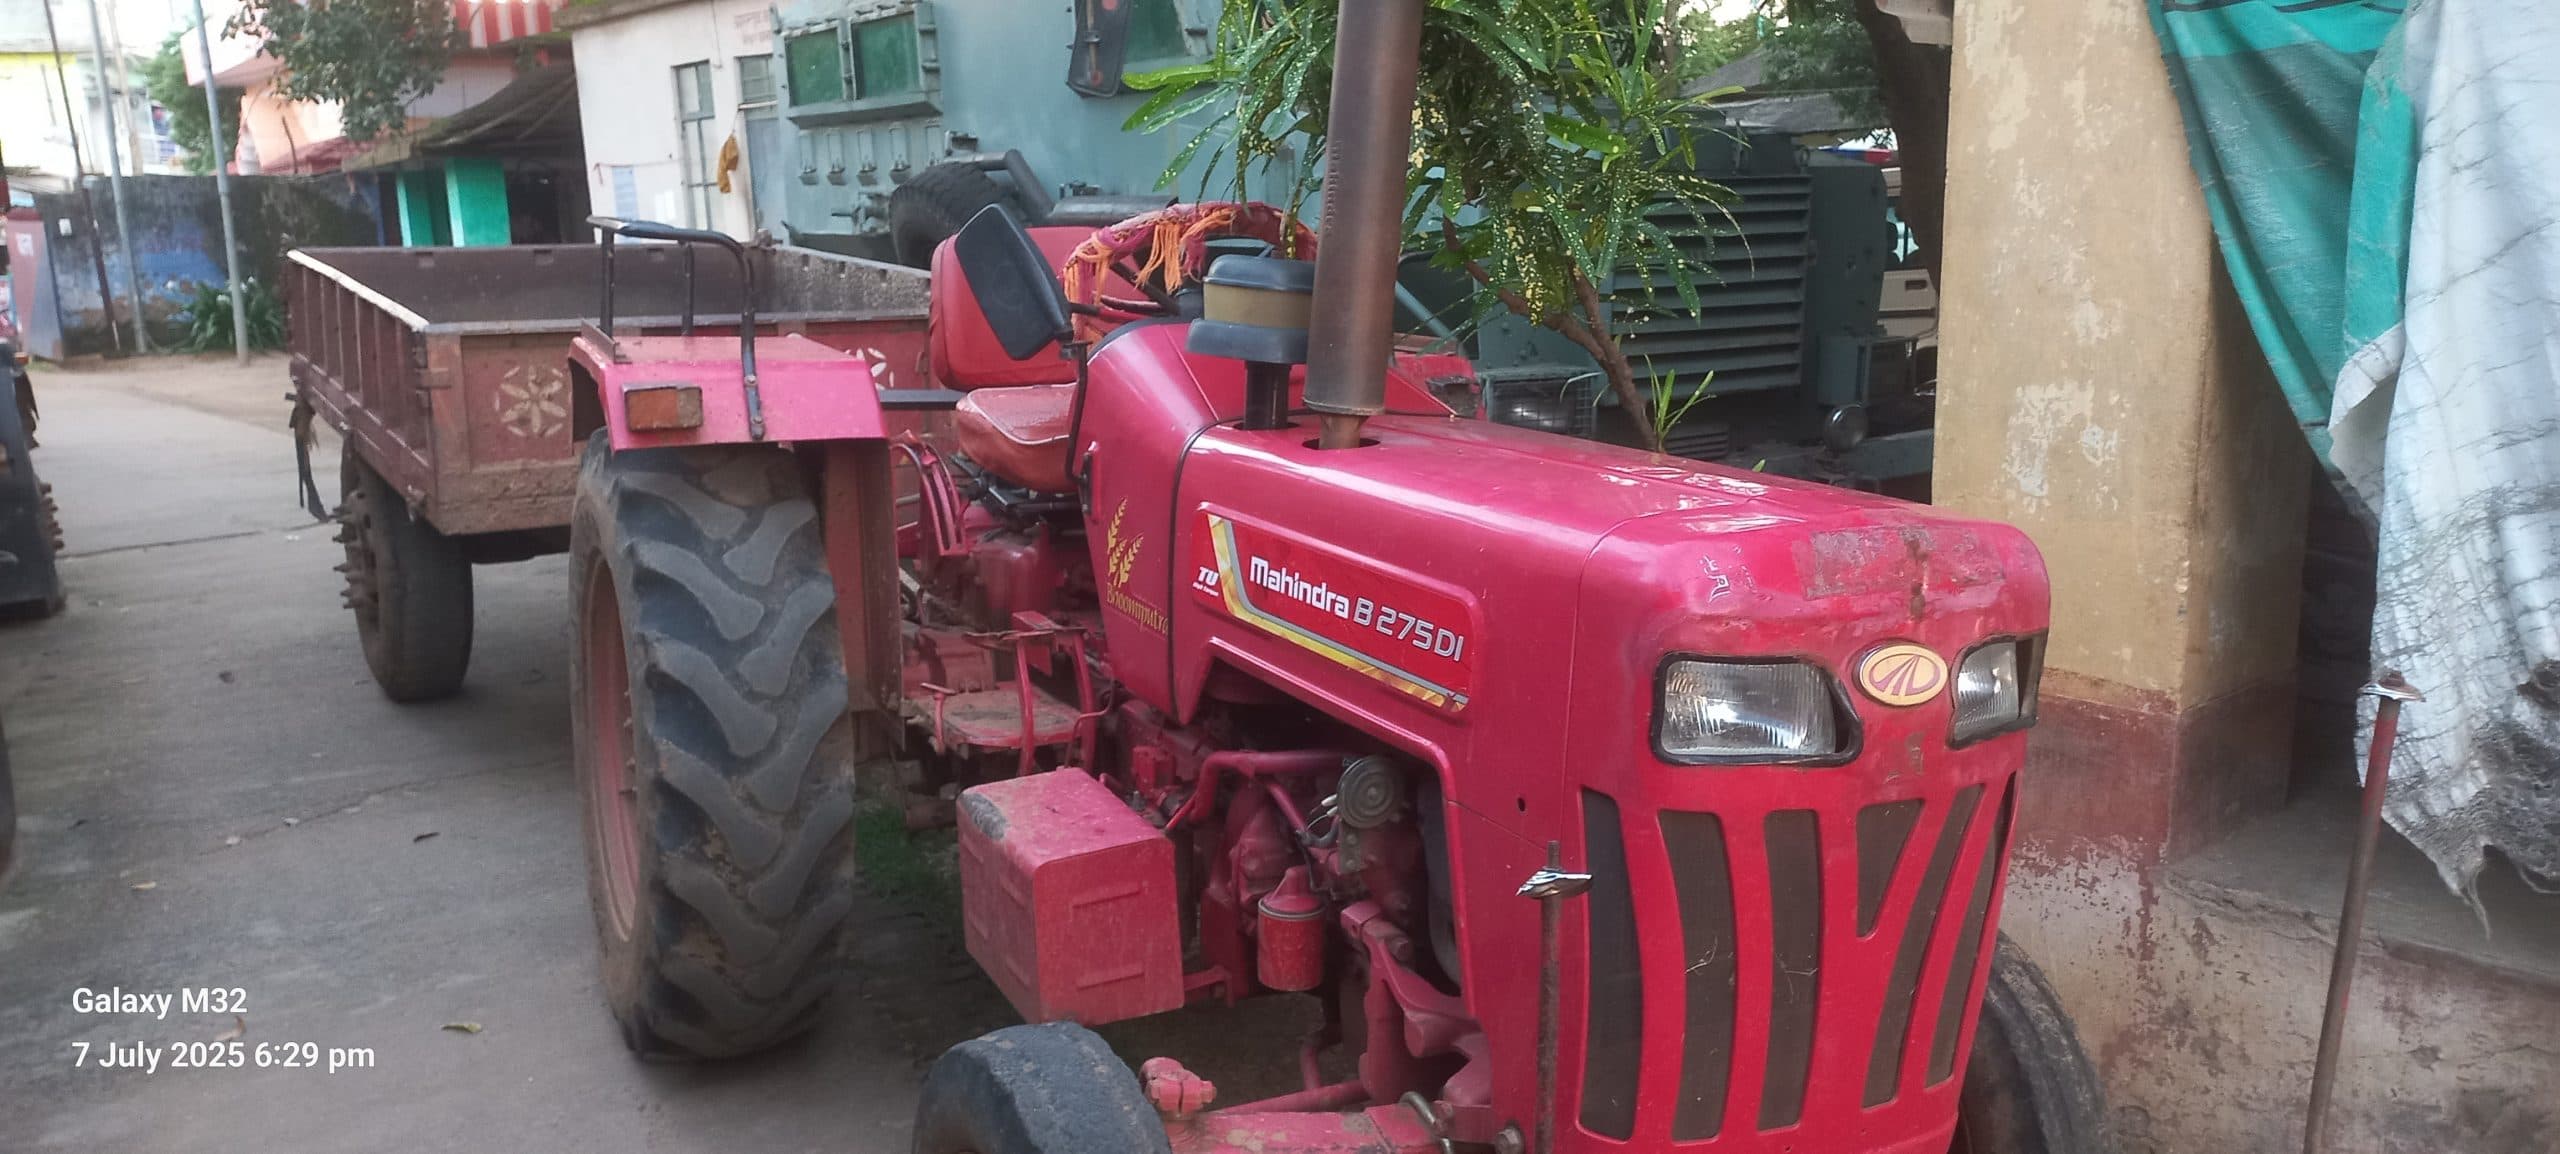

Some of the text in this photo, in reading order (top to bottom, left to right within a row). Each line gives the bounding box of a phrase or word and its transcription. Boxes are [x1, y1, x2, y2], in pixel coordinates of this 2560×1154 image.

[1198, 566, 1219, 586] TU
[1249, 556, 1350, 619] Mahindra
[1354, 597, 1375, 627] B
